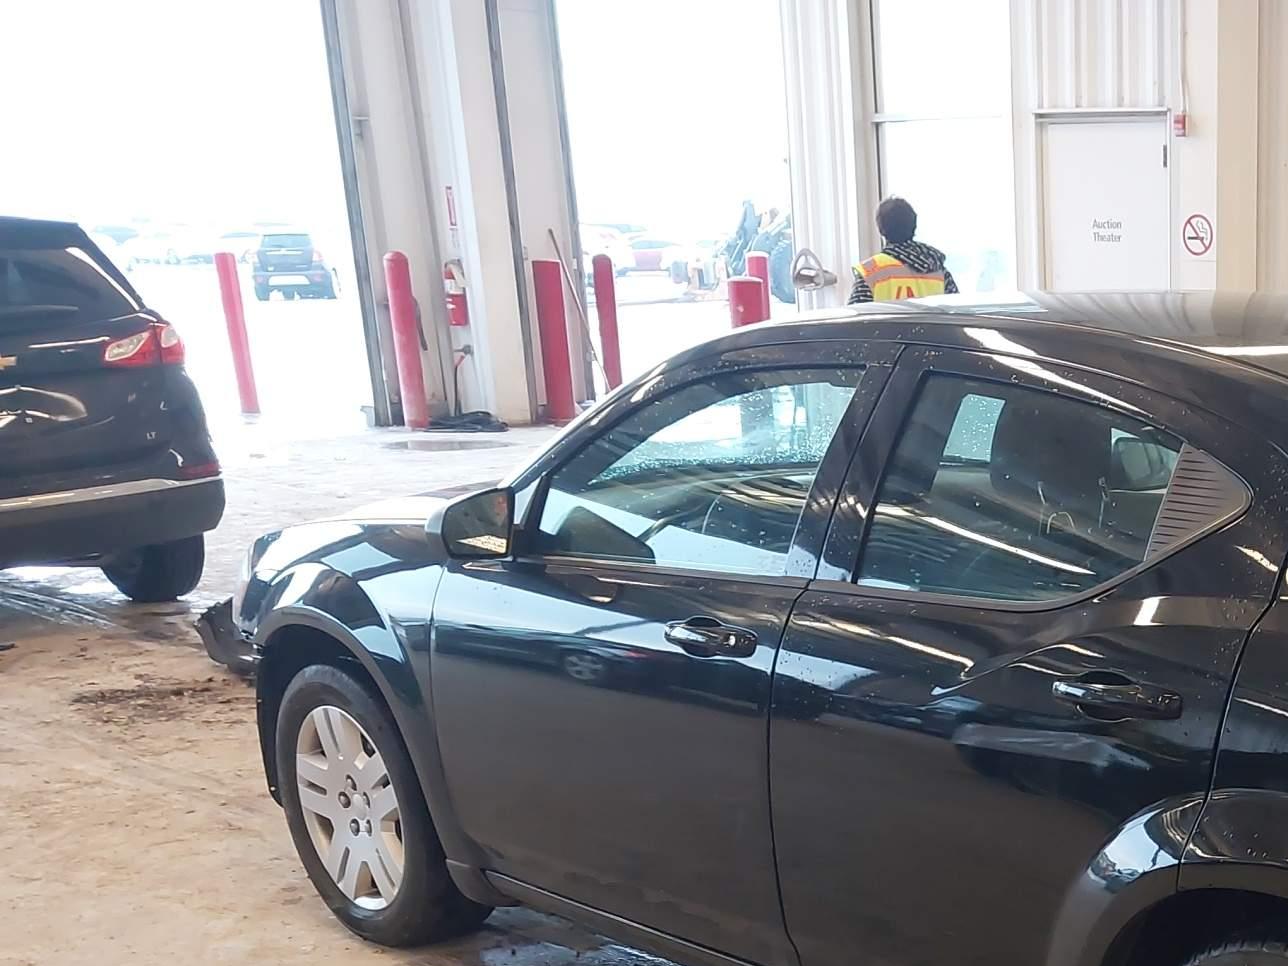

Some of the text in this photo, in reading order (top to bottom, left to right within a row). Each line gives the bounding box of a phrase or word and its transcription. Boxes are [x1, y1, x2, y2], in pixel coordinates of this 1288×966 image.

[1092, 218, 1122, 229] Auction
[1093, 231, 1122, 242] Theater
[146, 431, 157, 440] LT
